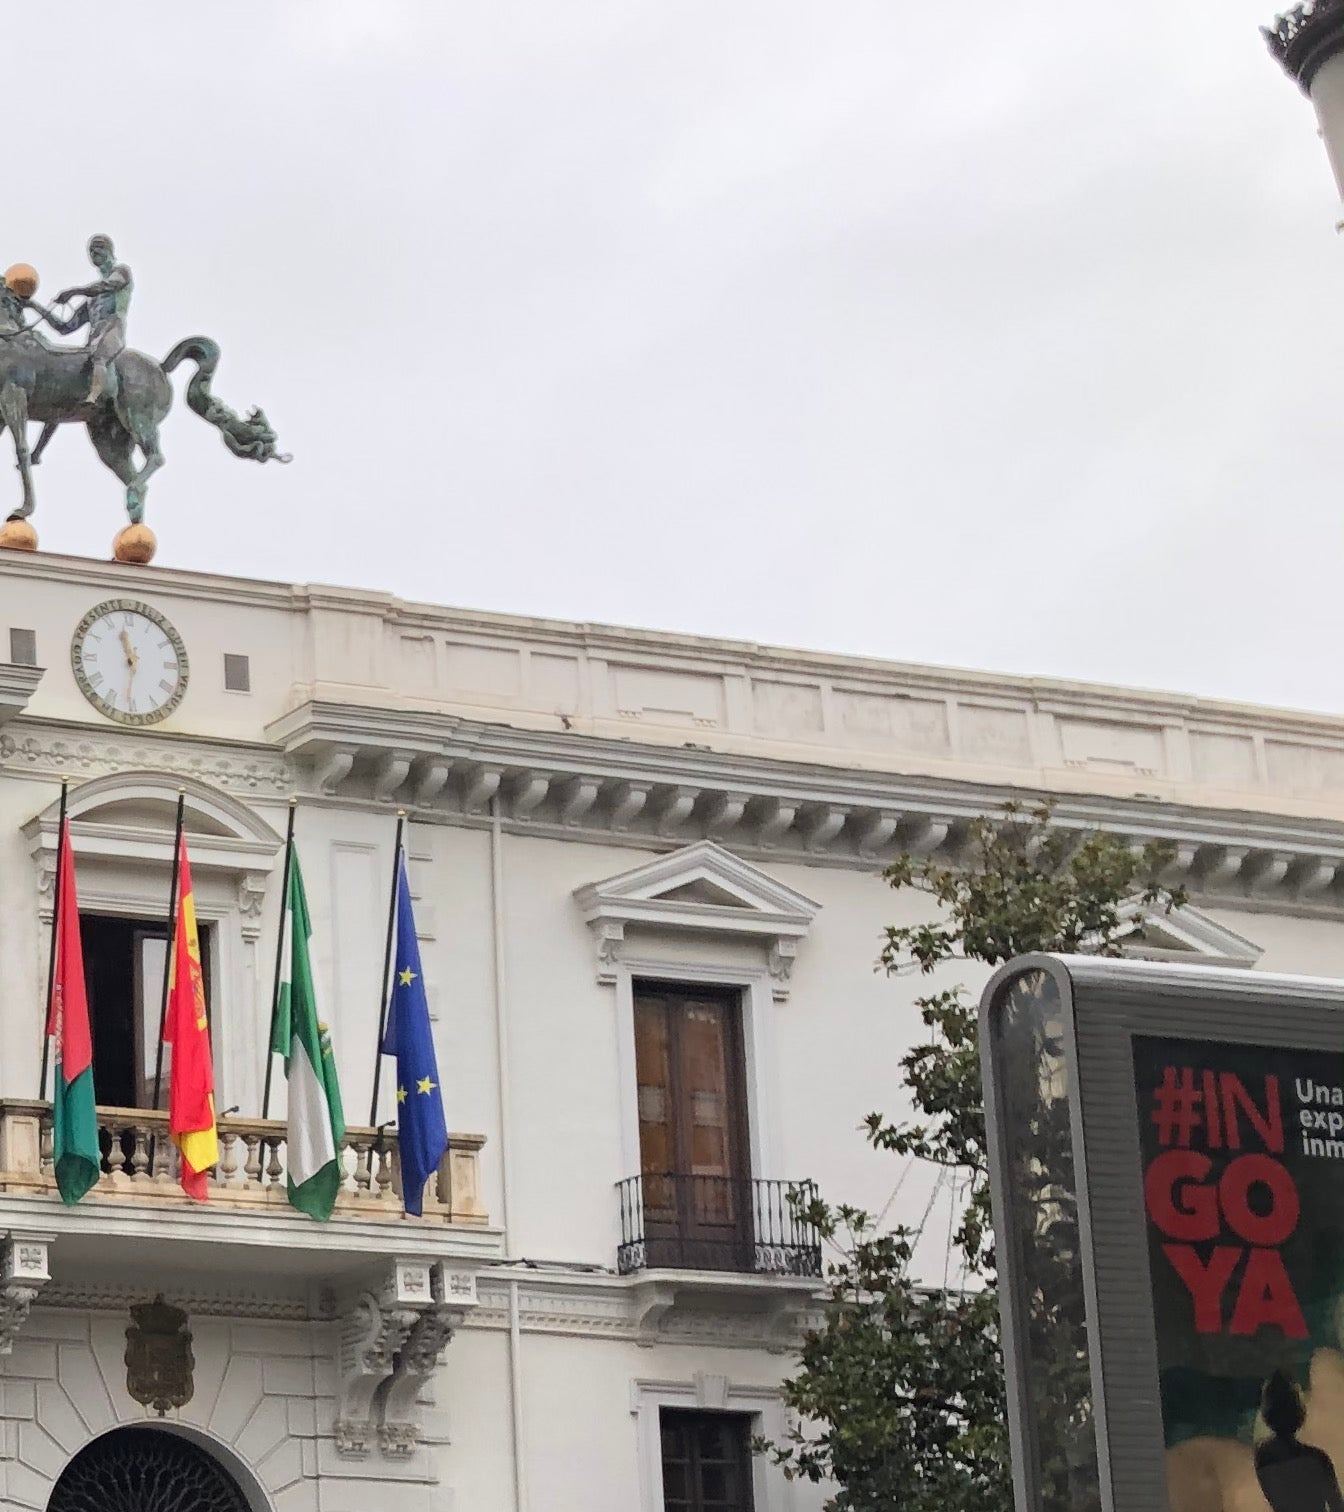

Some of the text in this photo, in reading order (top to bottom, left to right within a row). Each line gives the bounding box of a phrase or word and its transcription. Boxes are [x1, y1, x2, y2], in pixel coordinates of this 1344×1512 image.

[1151, 1065, 1285, 1153] #IN
[1296, 1078, 1343, 1105] Una
[1144, 1150, 1300, 1245] GO
[1163, 1244, 1311, 1339] YA
